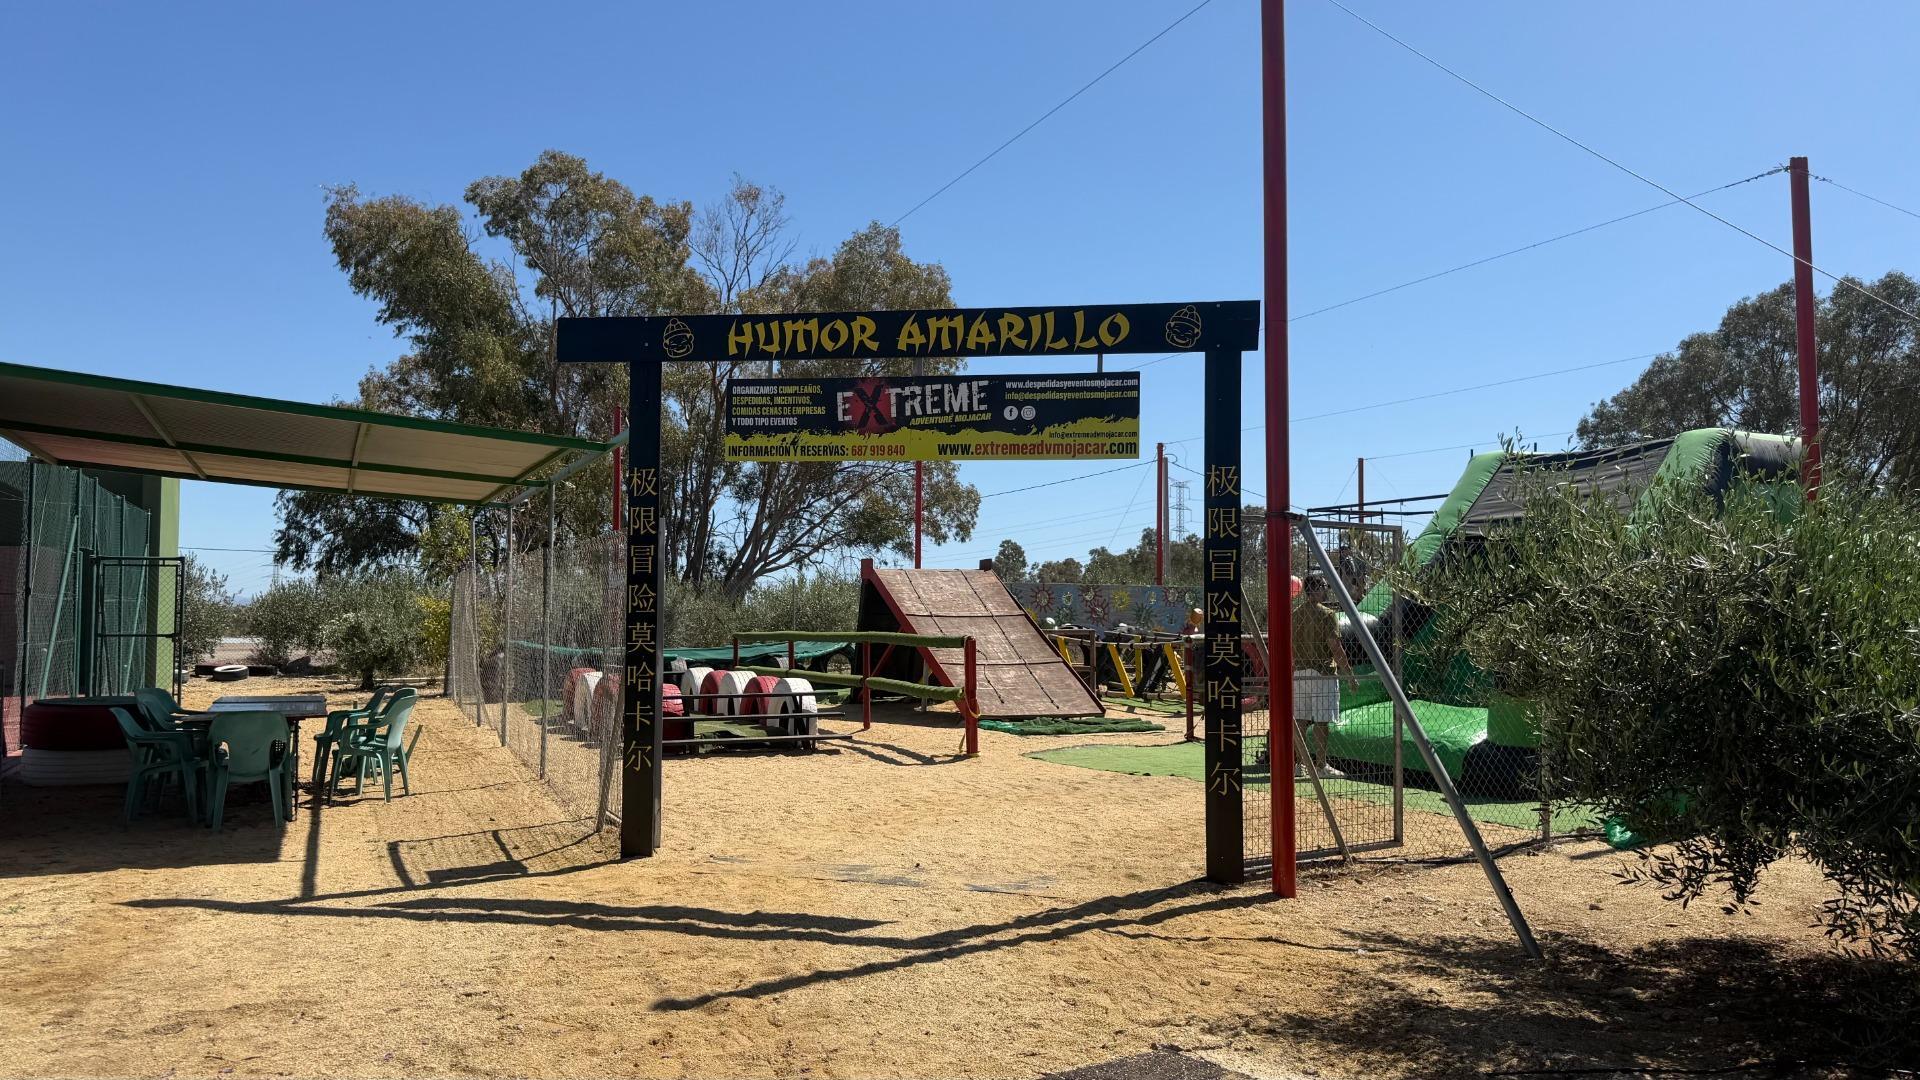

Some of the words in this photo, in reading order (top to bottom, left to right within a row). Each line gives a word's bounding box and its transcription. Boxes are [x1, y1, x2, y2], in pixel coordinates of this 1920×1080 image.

[728, 316, 880, 359] HUMOR
[896, 310, 1130, 355] AMARILLO
[732, 385, 778, 395] ORGANIZAMOS
[778, 383, 823, 395] CUMPLEAÑOS,
[1005, 378, 1139, 389] www.despedidasyeventosmojacar.com
[732, 396, 773, 406] DESPEDIDAS,
[773, 396, 812, 405] INCENTIVOS,
[1005, 390, 1138, 401] info@despedidasyeventosmojacar.com
[732, 406, 761, 416] COMIDAS
[761, 406, 782, 416] CENAS
[783, 406, 791, 416] DE
[792, 406, 826, 415] EMPRESAS
[731, 417, 737, 426] Y
[737, 417, 754, 426] TODO
[755, 417, 769, 426] TIPO
[770, 417, 798, 426] EVENTOS
[909, 415, 953, 426] ADVENTURE
[954, 412, 992, 423] MOJACAR
[792, 445, 798, 456] Y
[800, 444, 849, 456] RESERVAS:
[851, 445, 869, 456] 687
[870, 445, 885, 456] 919
[887, 444, 906, 456] 840
[937, 439, 1137, 458] www.extremeadvmojacar.com
[625, 468, 657, 771] 极限冒险莫哈卡尔
